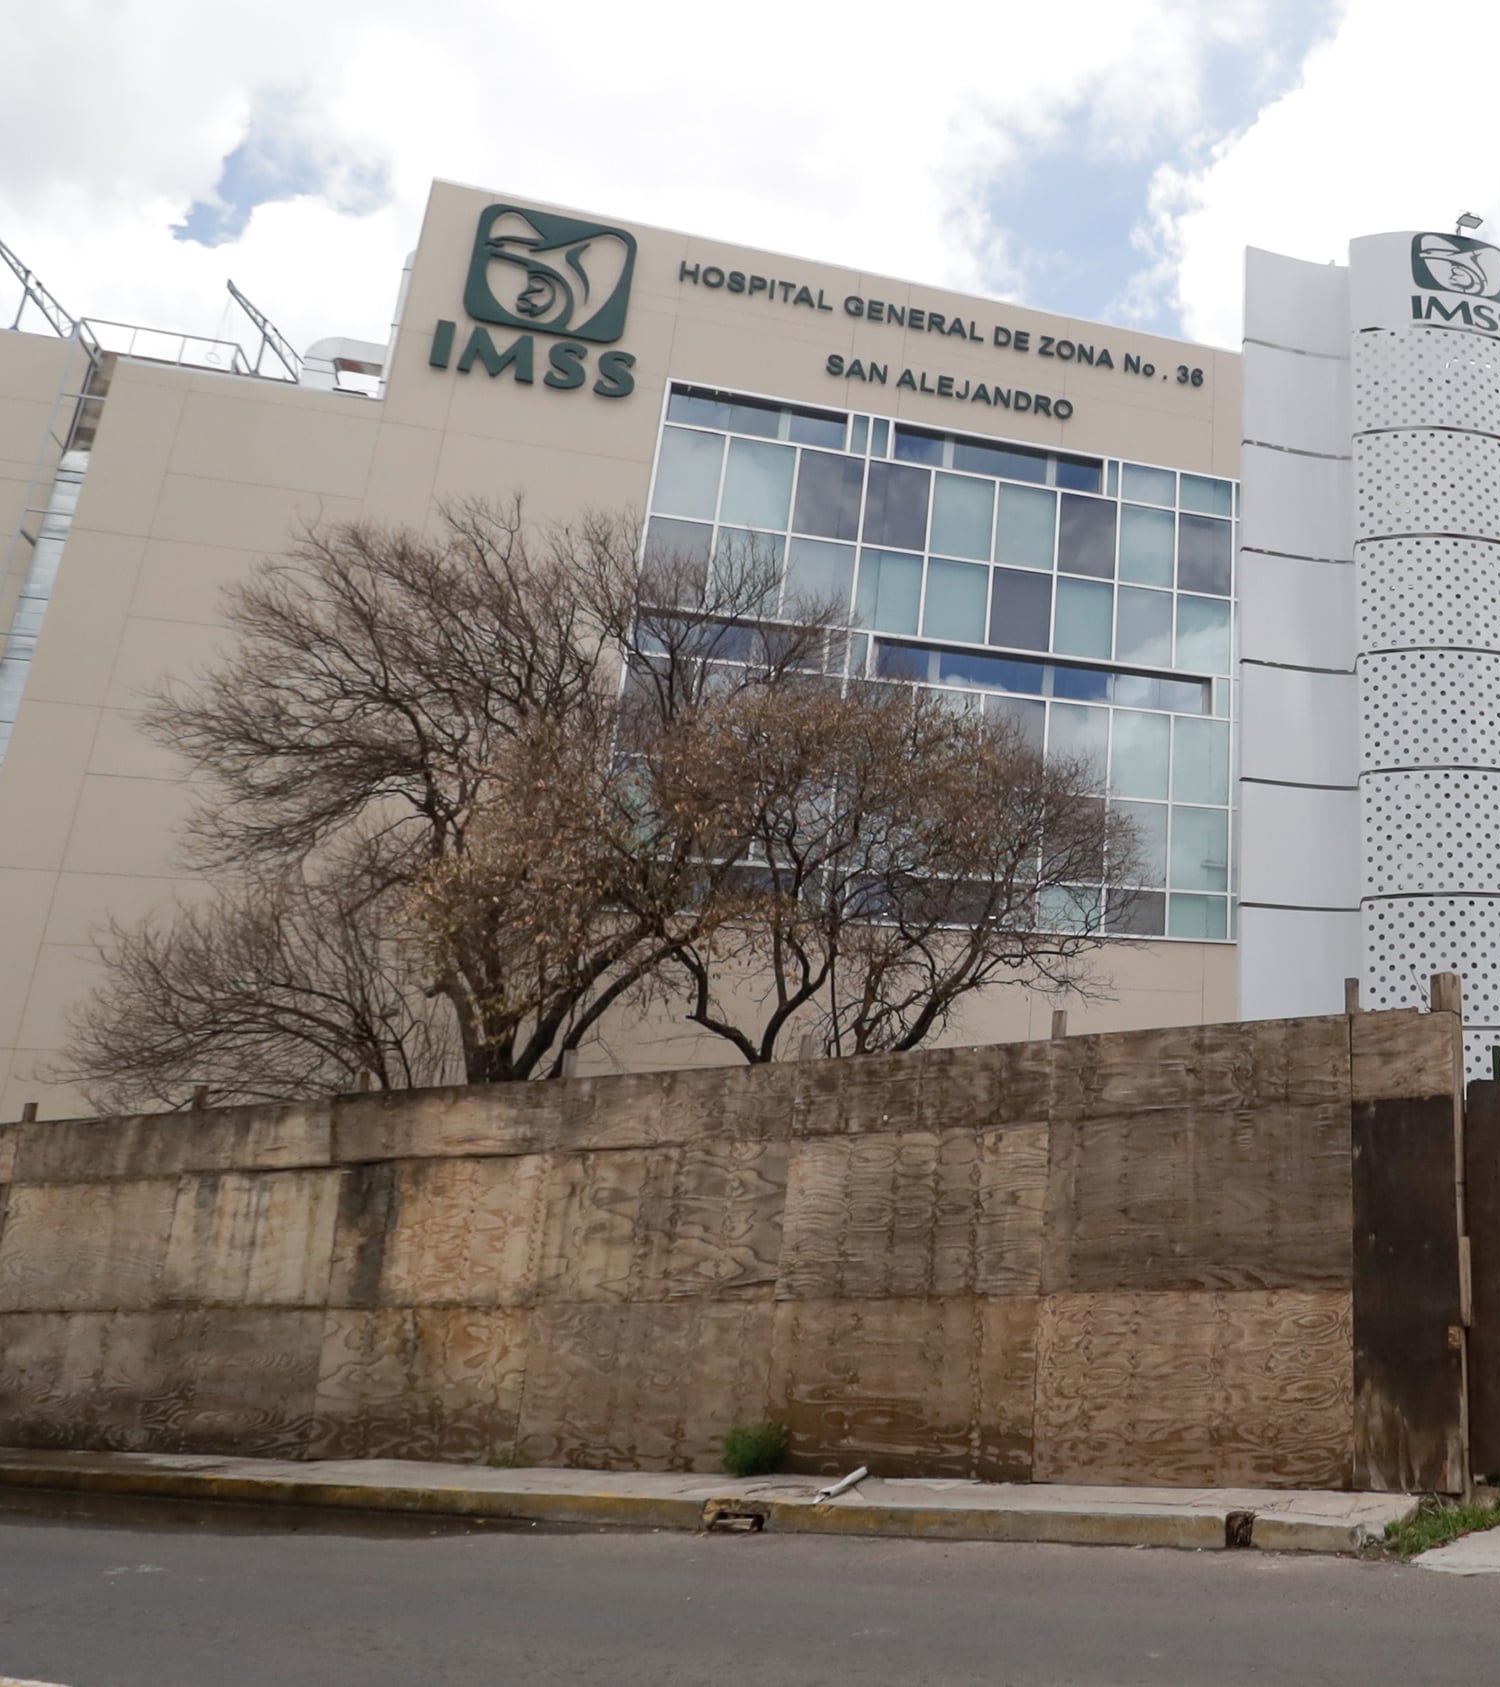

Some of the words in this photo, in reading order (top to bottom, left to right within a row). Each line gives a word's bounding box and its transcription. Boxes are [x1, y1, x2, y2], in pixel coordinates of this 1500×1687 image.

[429, 319, 637, 398] IMSS
[679, 260, 833, 312] HOSPITAL
[844, 295, 985, 343] GENERAL
[993, 326, 1030, 351] DE
[1038, 335, 1114, 370] ZONA
[1176, 364, 1205, 387] 36
[826, 354, 888, 385] SAN
[896, 368, 1074, 420] ALEJANDRO
